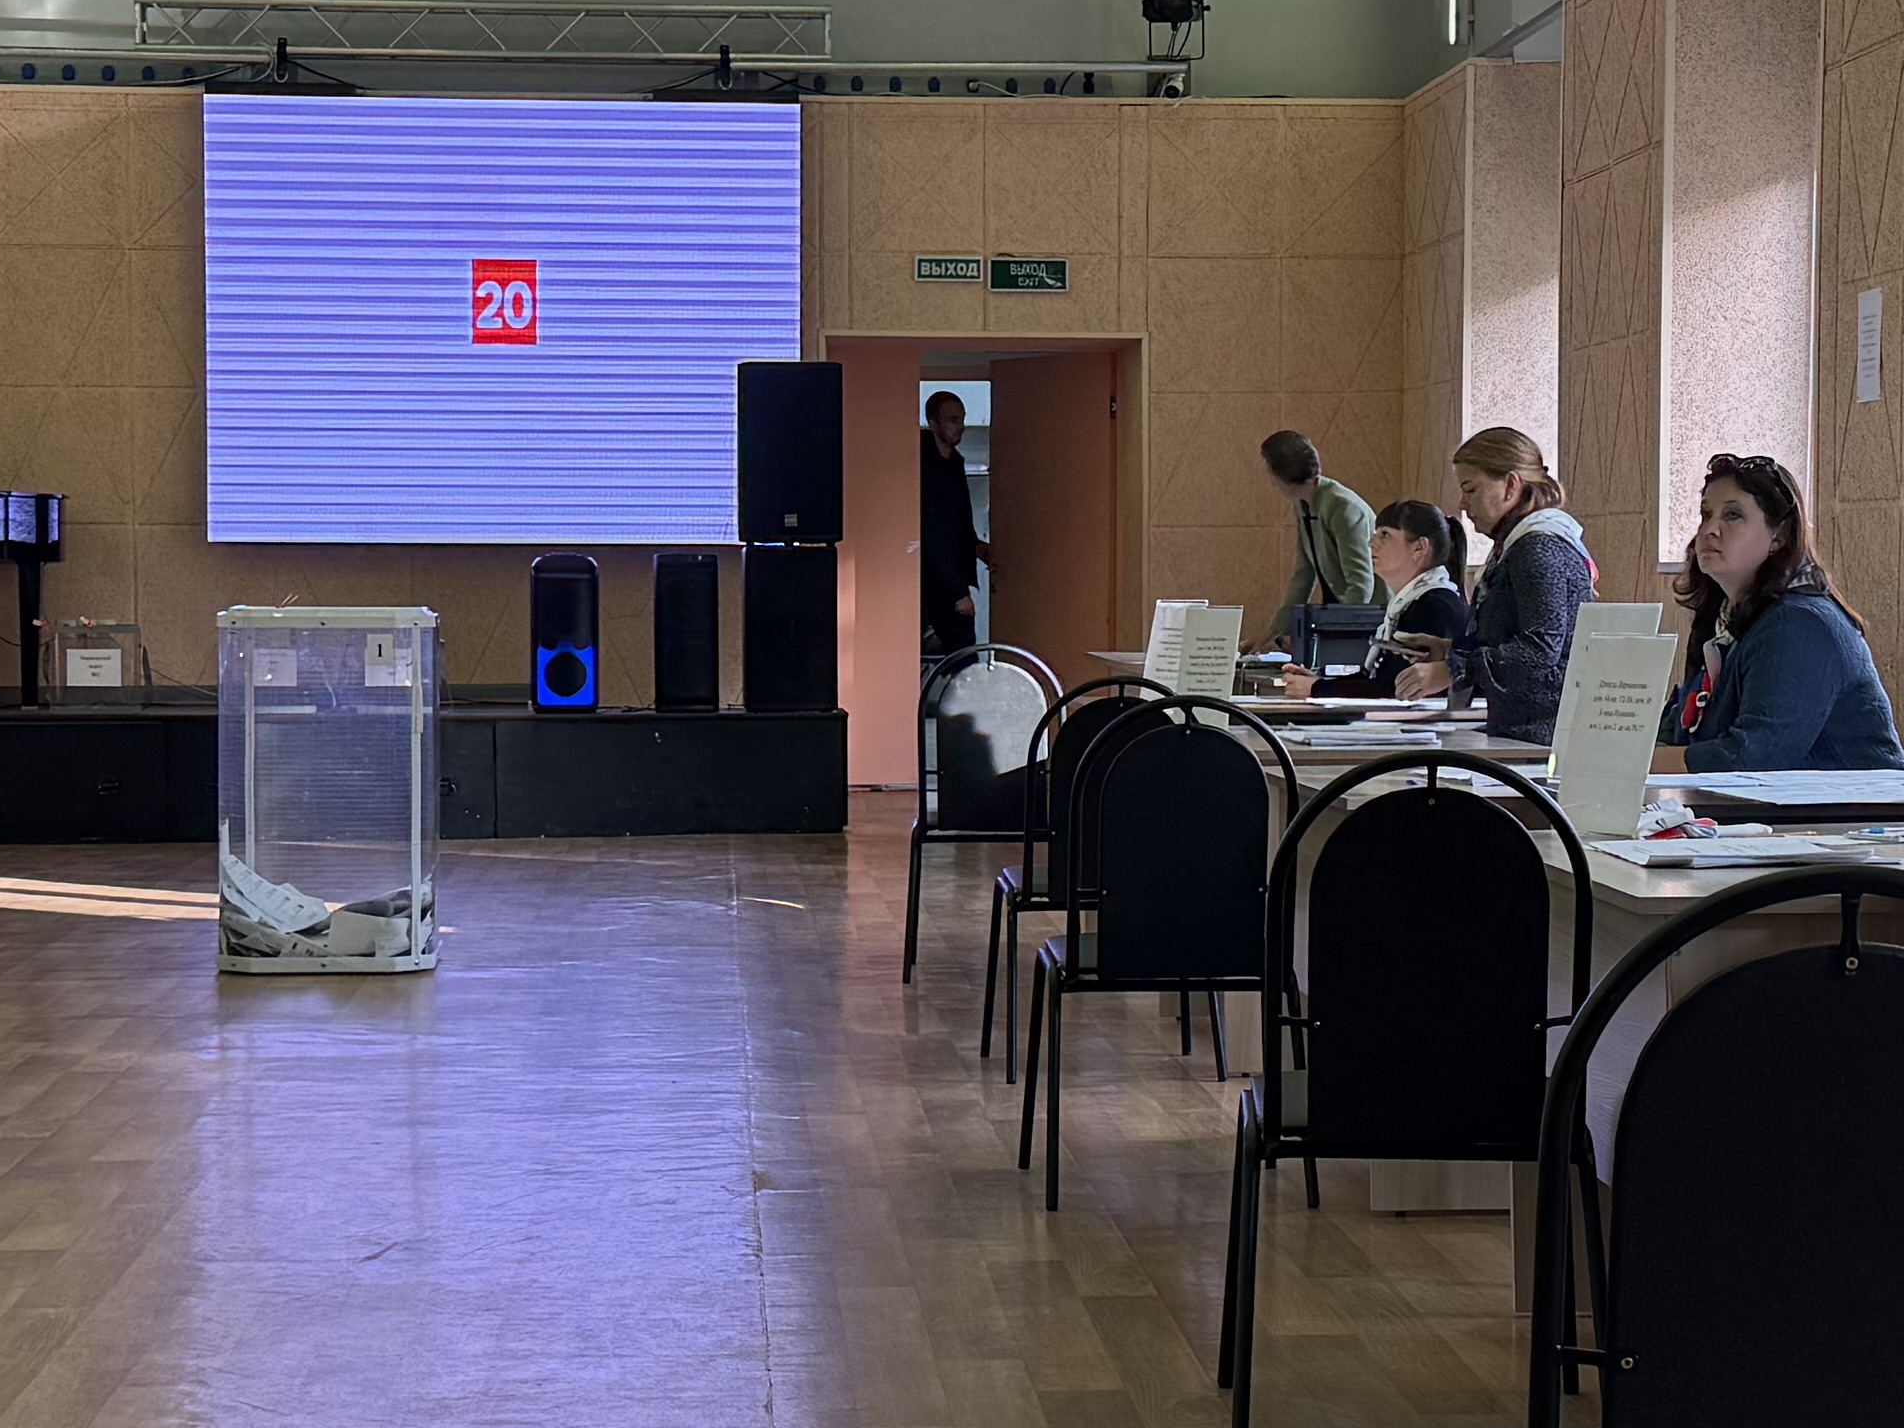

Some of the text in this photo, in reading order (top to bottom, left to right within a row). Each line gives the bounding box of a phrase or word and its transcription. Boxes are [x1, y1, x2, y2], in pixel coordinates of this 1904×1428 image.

[920, 262, 979, 277] ВЫХОД
[1010, 263, 1046, 277] ВЫХОД
[476, 280, 533, 329] 20
[377, 643, 383, 658] 1
